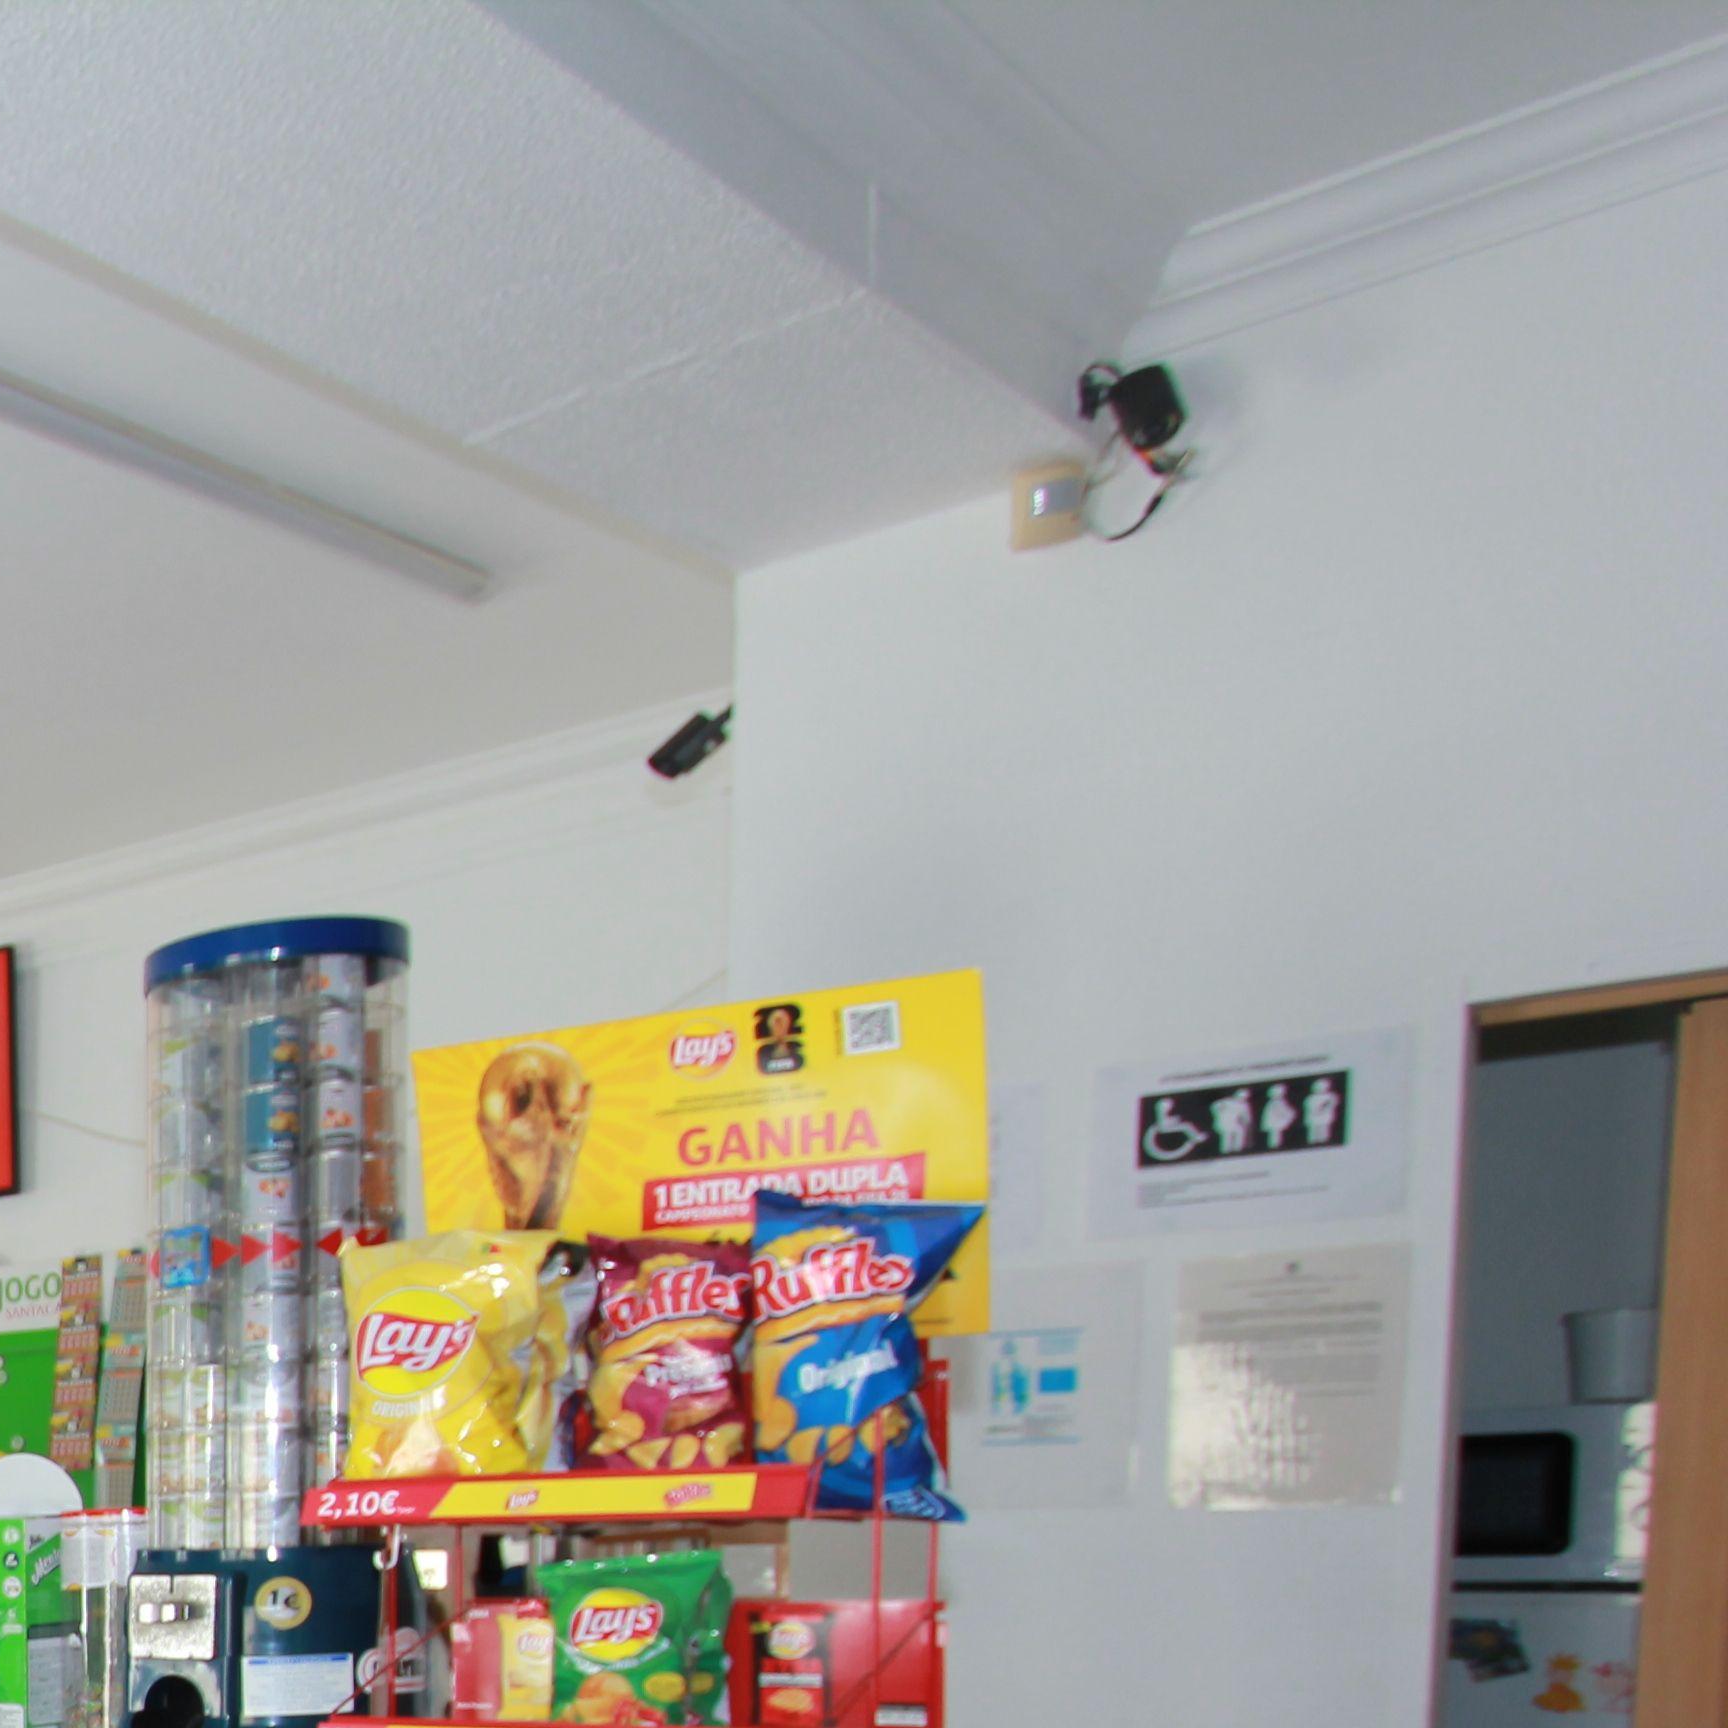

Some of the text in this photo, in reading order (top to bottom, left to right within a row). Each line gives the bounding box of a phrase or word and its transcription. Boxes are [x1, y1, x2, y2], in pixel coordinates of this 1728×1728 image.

[677, 1108, 880, 1167] GANHA
[671, 1167, 803, 1208] ENTRADA
[808, 1162, 910, 1195] DUPLA
[753, 1242, 913, 1316] Ruffles
[6, 1304, 62, 1319] SANTACA
[357, 1313, 476, 1373] Lay's
[318, 1489, 400, 1519] 2,10€
